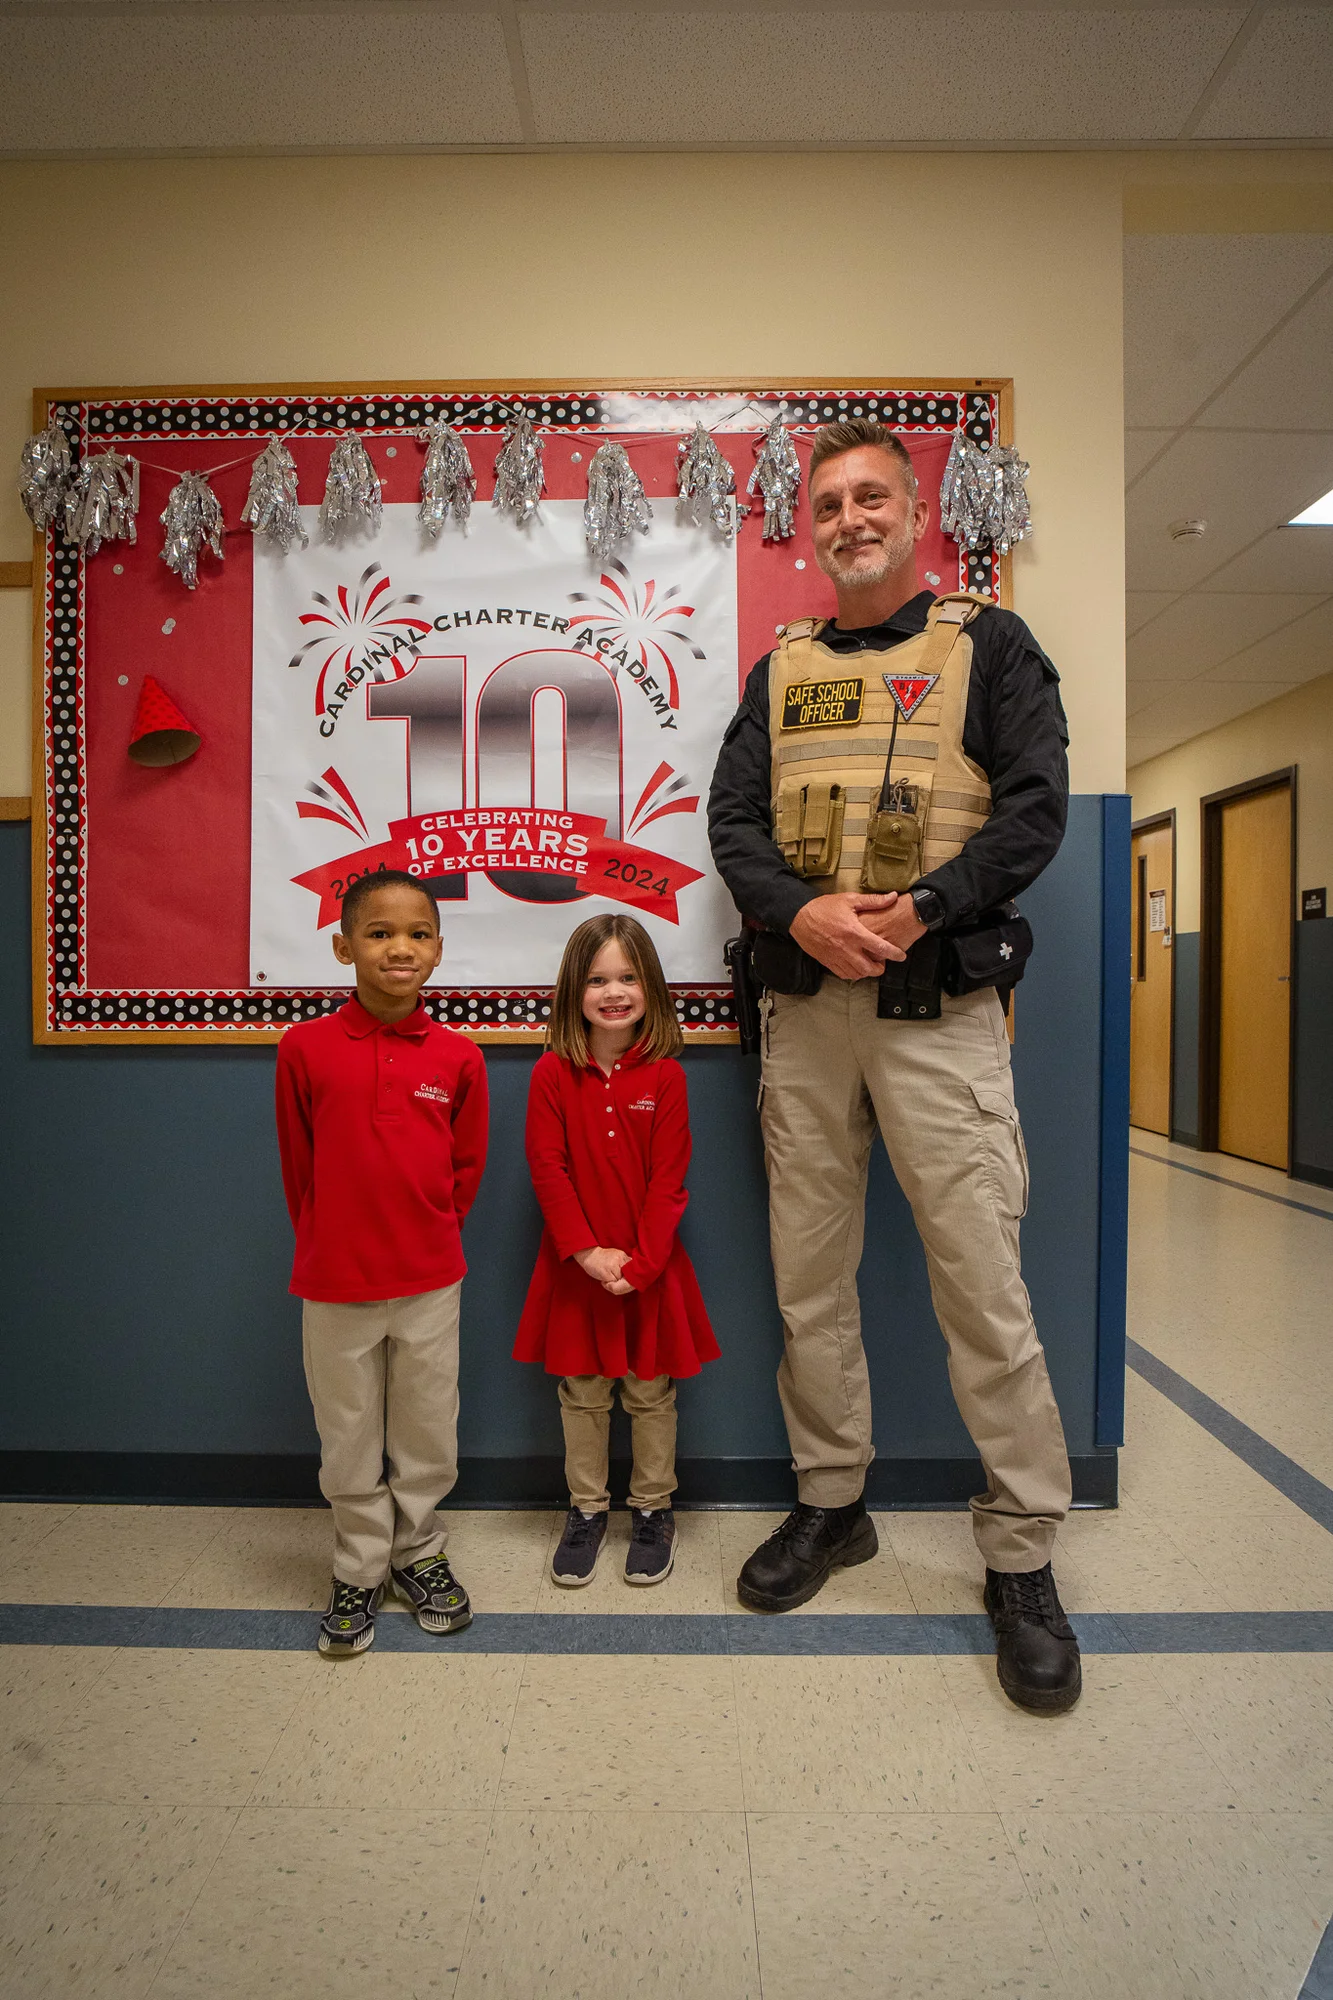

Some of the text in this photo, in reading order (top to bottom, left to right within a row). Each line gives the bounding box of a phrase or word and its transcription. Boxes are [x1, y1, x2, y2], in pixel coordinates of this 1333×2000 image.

[319, 608, 679, 737] CARDINAL CHARTER ACADEMY
[787, 681, 860, 706] SAFE SCHOOL
[800, 701, 845, 723] OFFICER
[366, 648, 624, 904] 10
[420, 811, 573, 831] CELEBRATING
[405, 827, 589, 860] 10 YEARS
[330, 861, 387, 900] 20
[407, 854, 589, 876] OF EXCELLENCE
[603, 858, 670, 896] 2024
